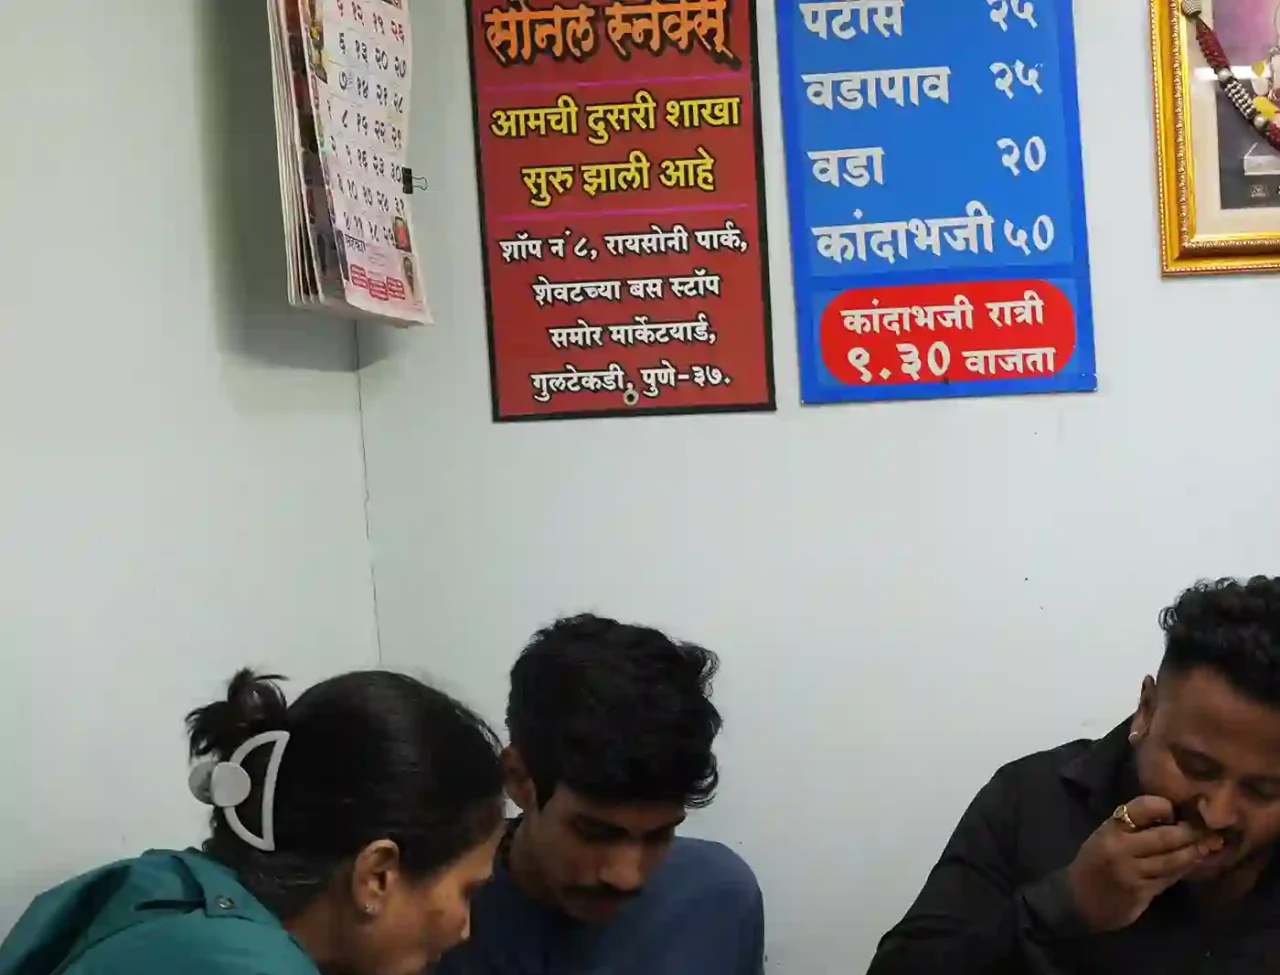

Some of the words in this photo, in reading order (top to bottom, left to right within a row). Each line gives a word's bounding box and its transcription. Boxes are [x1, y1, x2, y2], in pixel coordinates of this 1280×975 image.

[801, 66, 951, 110] वडापाव
[989, 59, 1043, 99] २५
[491, 95, 578, 137] आमची
[586, 90, 657, 145] दुसरी
[666, 97, 741, 128] शाखा
[522, 164, 574, 207] सुरु
[581, 150, 650, 196] झाली
[659, 147, 715, 191] आहे
[807, 147, 885, 187] वडा
[996, 136, 1047, 176] २०
[500, 231, 543, 262] शॉप
[605, 224, 689, 255] रायसोनी
[695, 220, 749, 252] पार्क,
[811, 200, 995, 264] कांदाभजी
[1004, 214, 1055, 256] ५०
[533, 275, 622, 306] शेवटच्या
[628, 278, 663, 299] बस
[669, 269, 722, 298] स्टॉप
[549, 318, 604, 348] समोर
[840, 293, 974, 335] कांदाभजी
[985, 290, 1044, 328] रात्री
[962, 347, 1057, 376] वाजता
